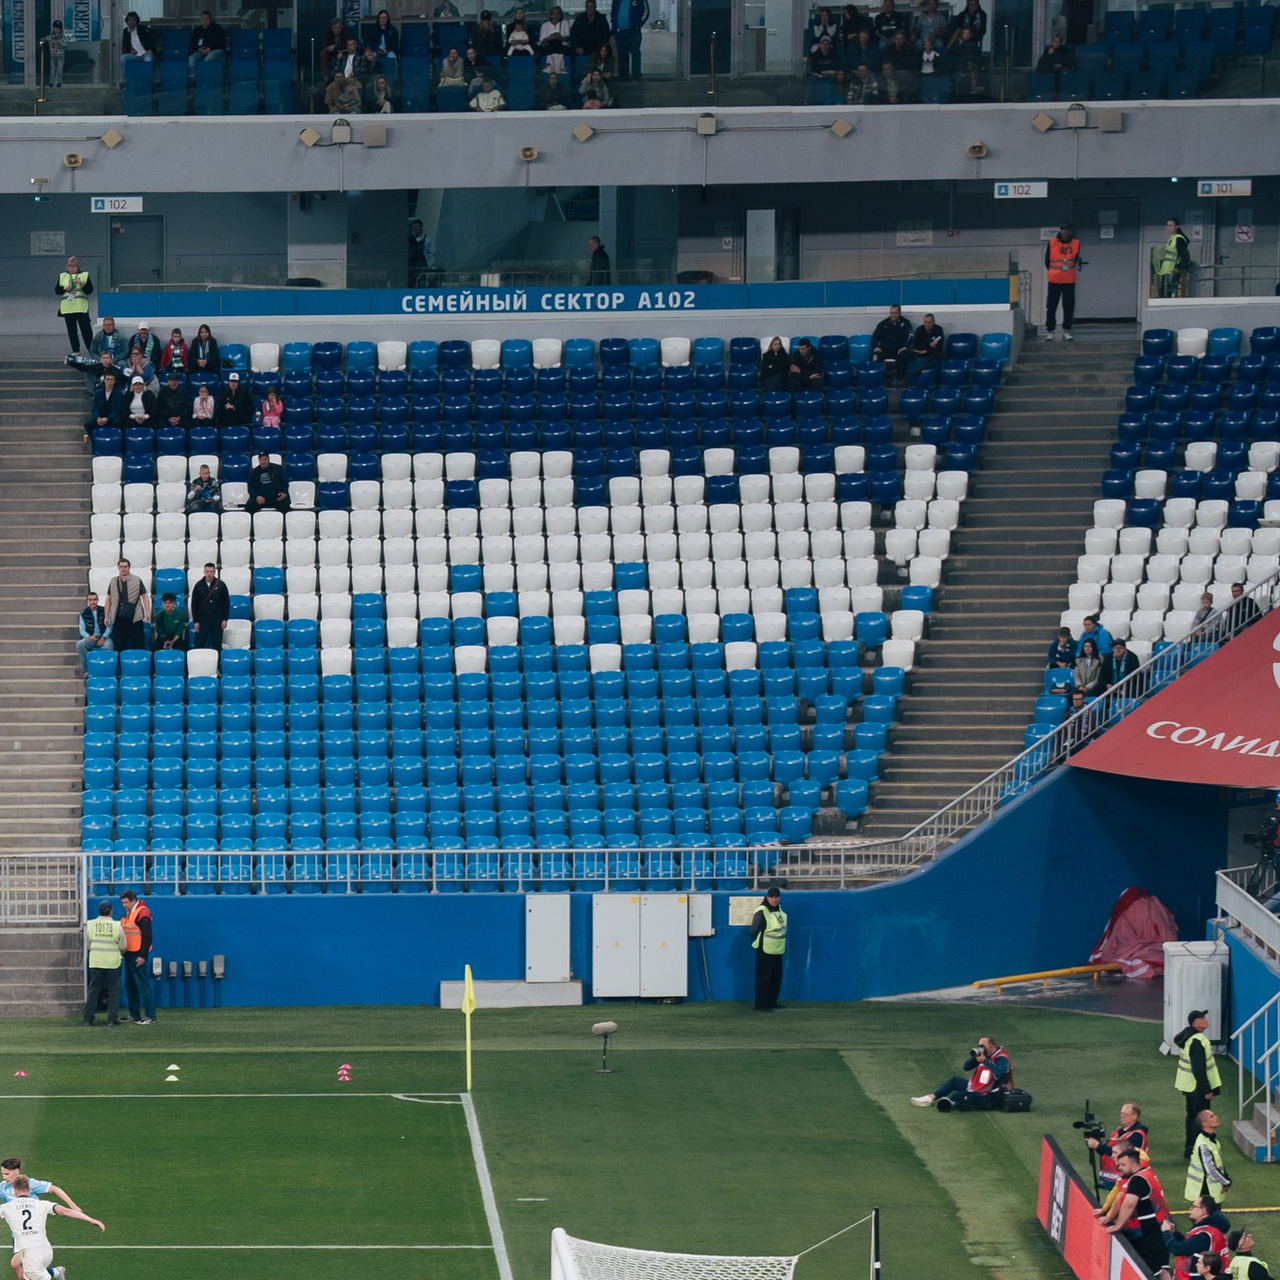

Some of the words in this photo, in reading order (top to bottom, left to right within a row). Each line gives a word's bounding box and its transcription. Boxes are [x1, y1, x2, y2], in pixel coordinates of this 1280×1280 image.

[1013, 185, 1030, 195] 102
[1215, 183, 1231, 193] 101
[109, 200, 127, 210] 102
[401, 290, 527, 313] СЕМЕЙНЫЙ
[541, 292, 625, 312] СЕКТОР
[1146, 721, 1280, 757] СОЛИД
[95, 922, 114, 933] 10178
[22, 1209, 33, 1231] 2
